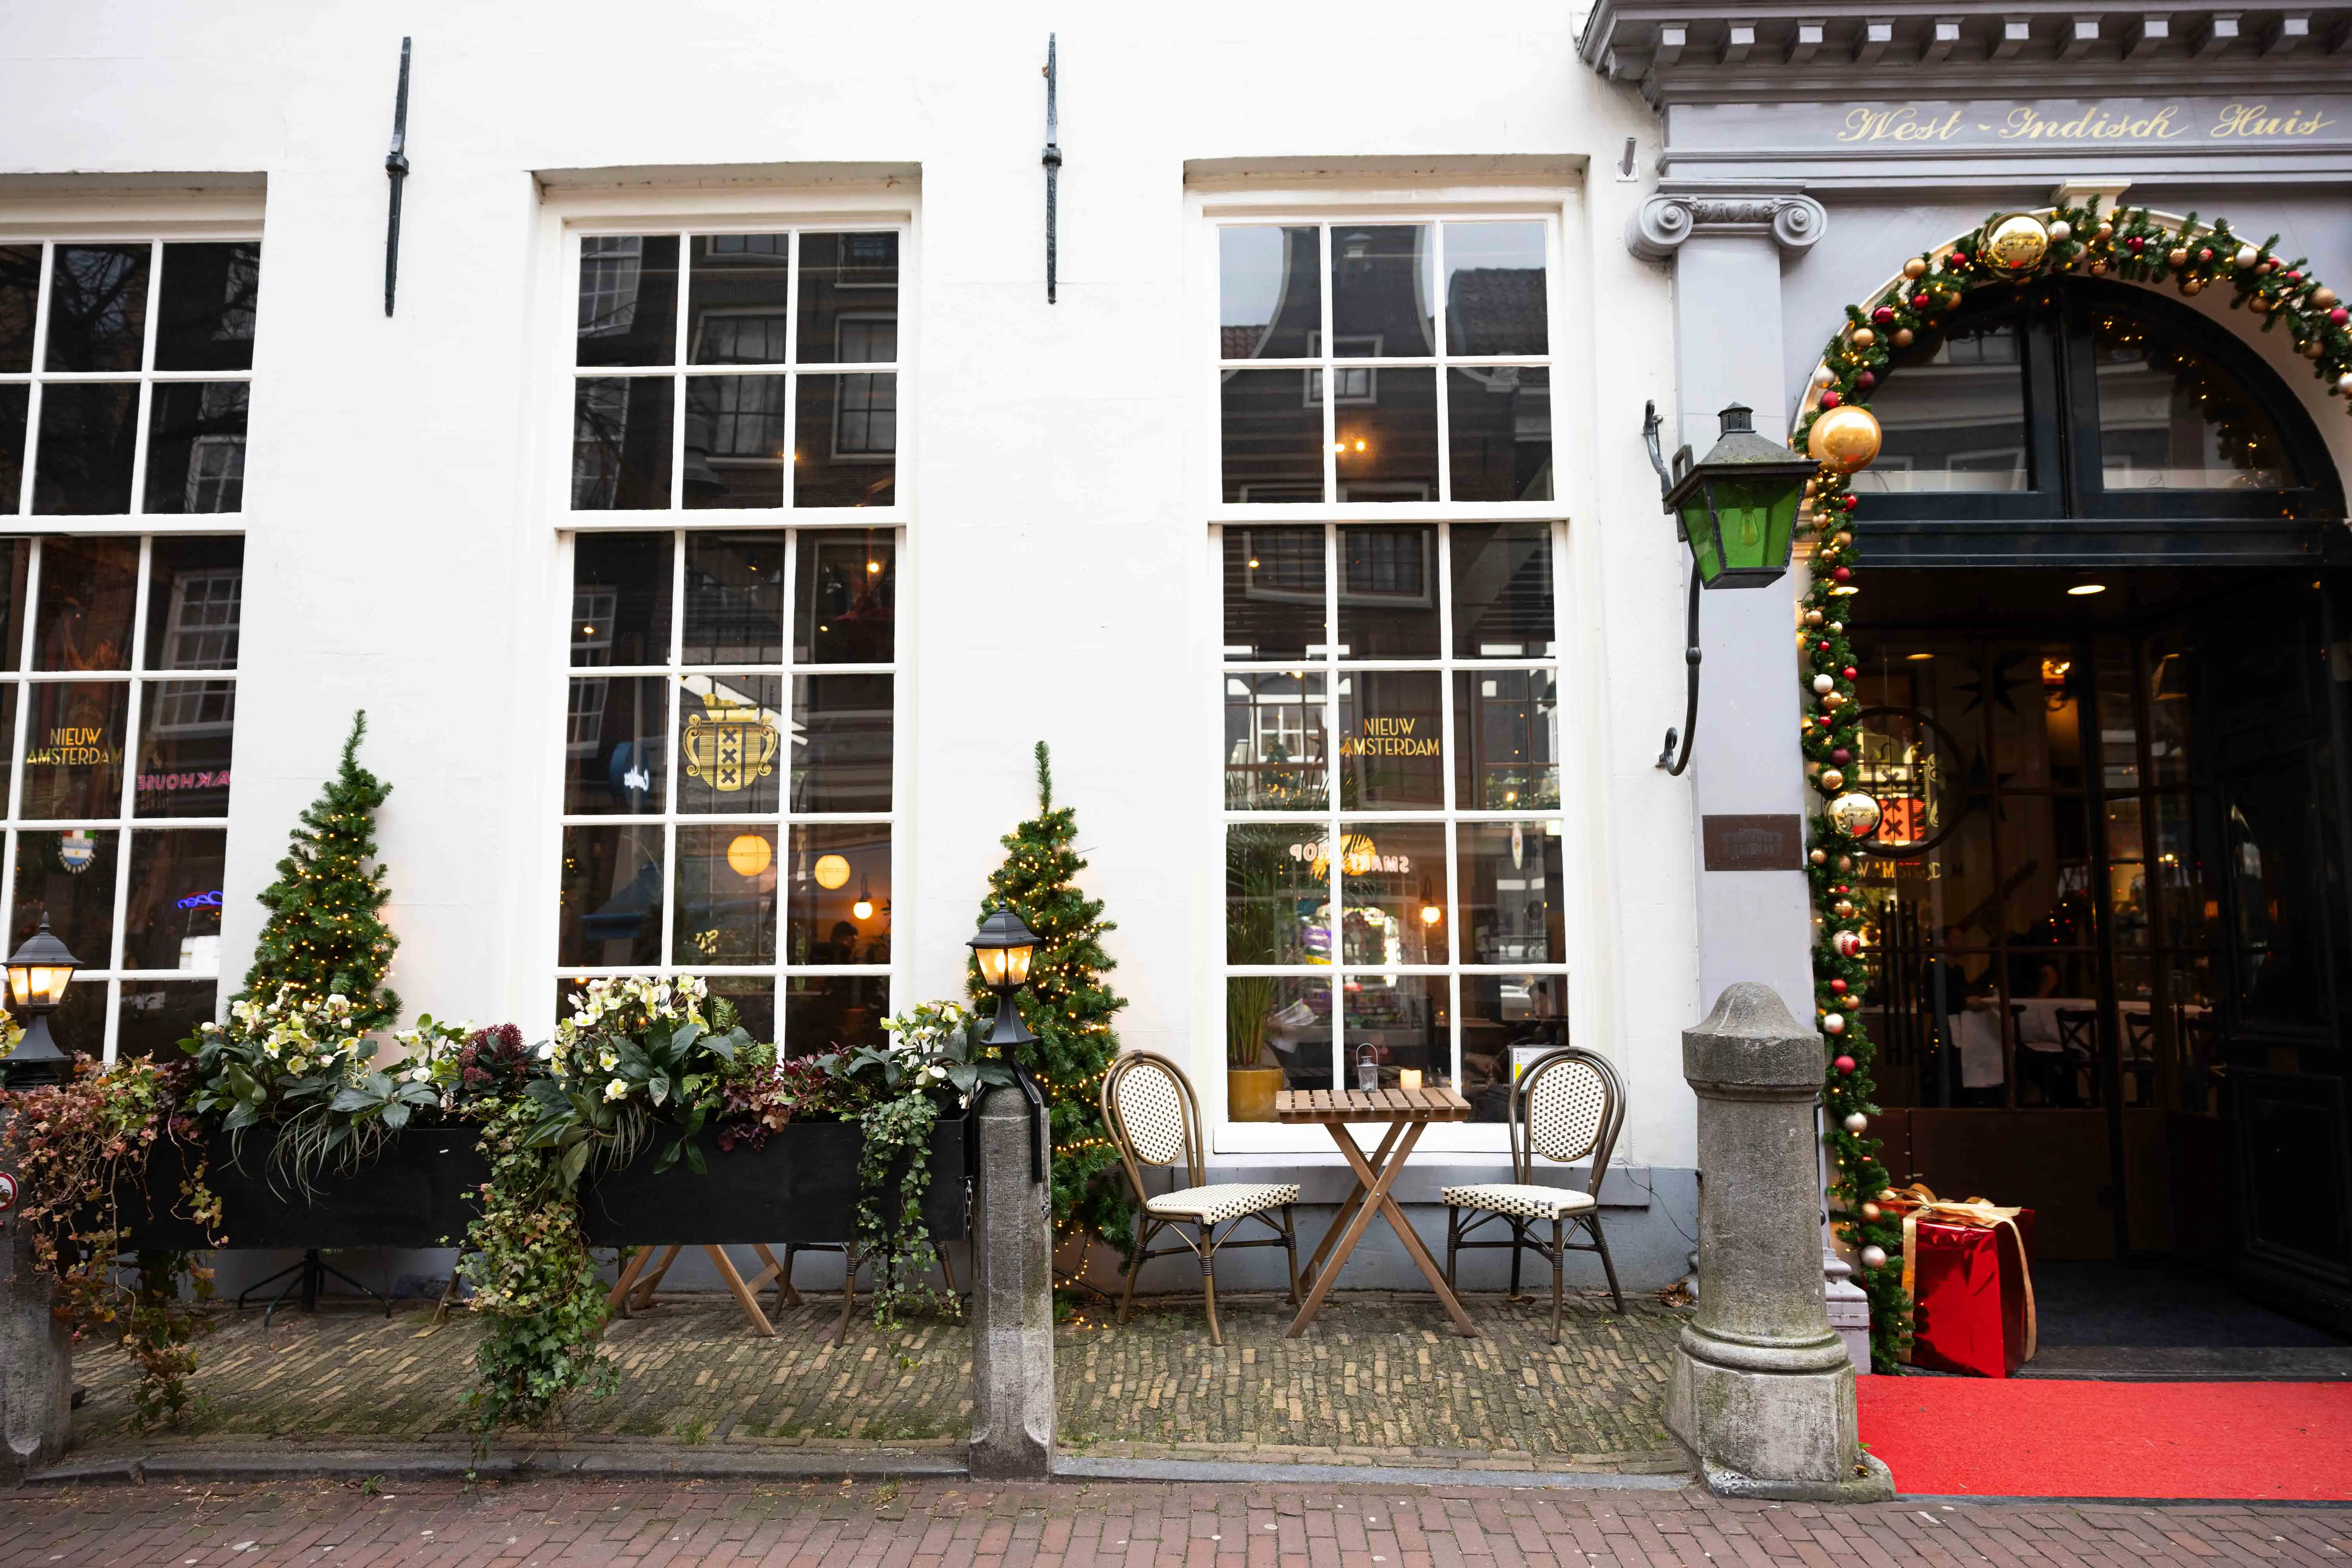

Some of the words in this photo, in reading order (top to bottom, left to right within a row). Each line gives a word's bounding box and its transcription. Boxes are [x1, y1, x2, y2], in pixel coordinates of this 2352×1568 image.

[1836, 107, 1965, 141] West
[1998, 105, 2189, 139] Indisch
[2209, 103, 2336, 137] Huis
[1364, 717, 1415, 736] NIEUW
[49, 728, 102, 745] NIEUW
[26, 747, 123, 765] AMSTERDAM
[1339, 737, 1440, 756] AMSTERDAM
